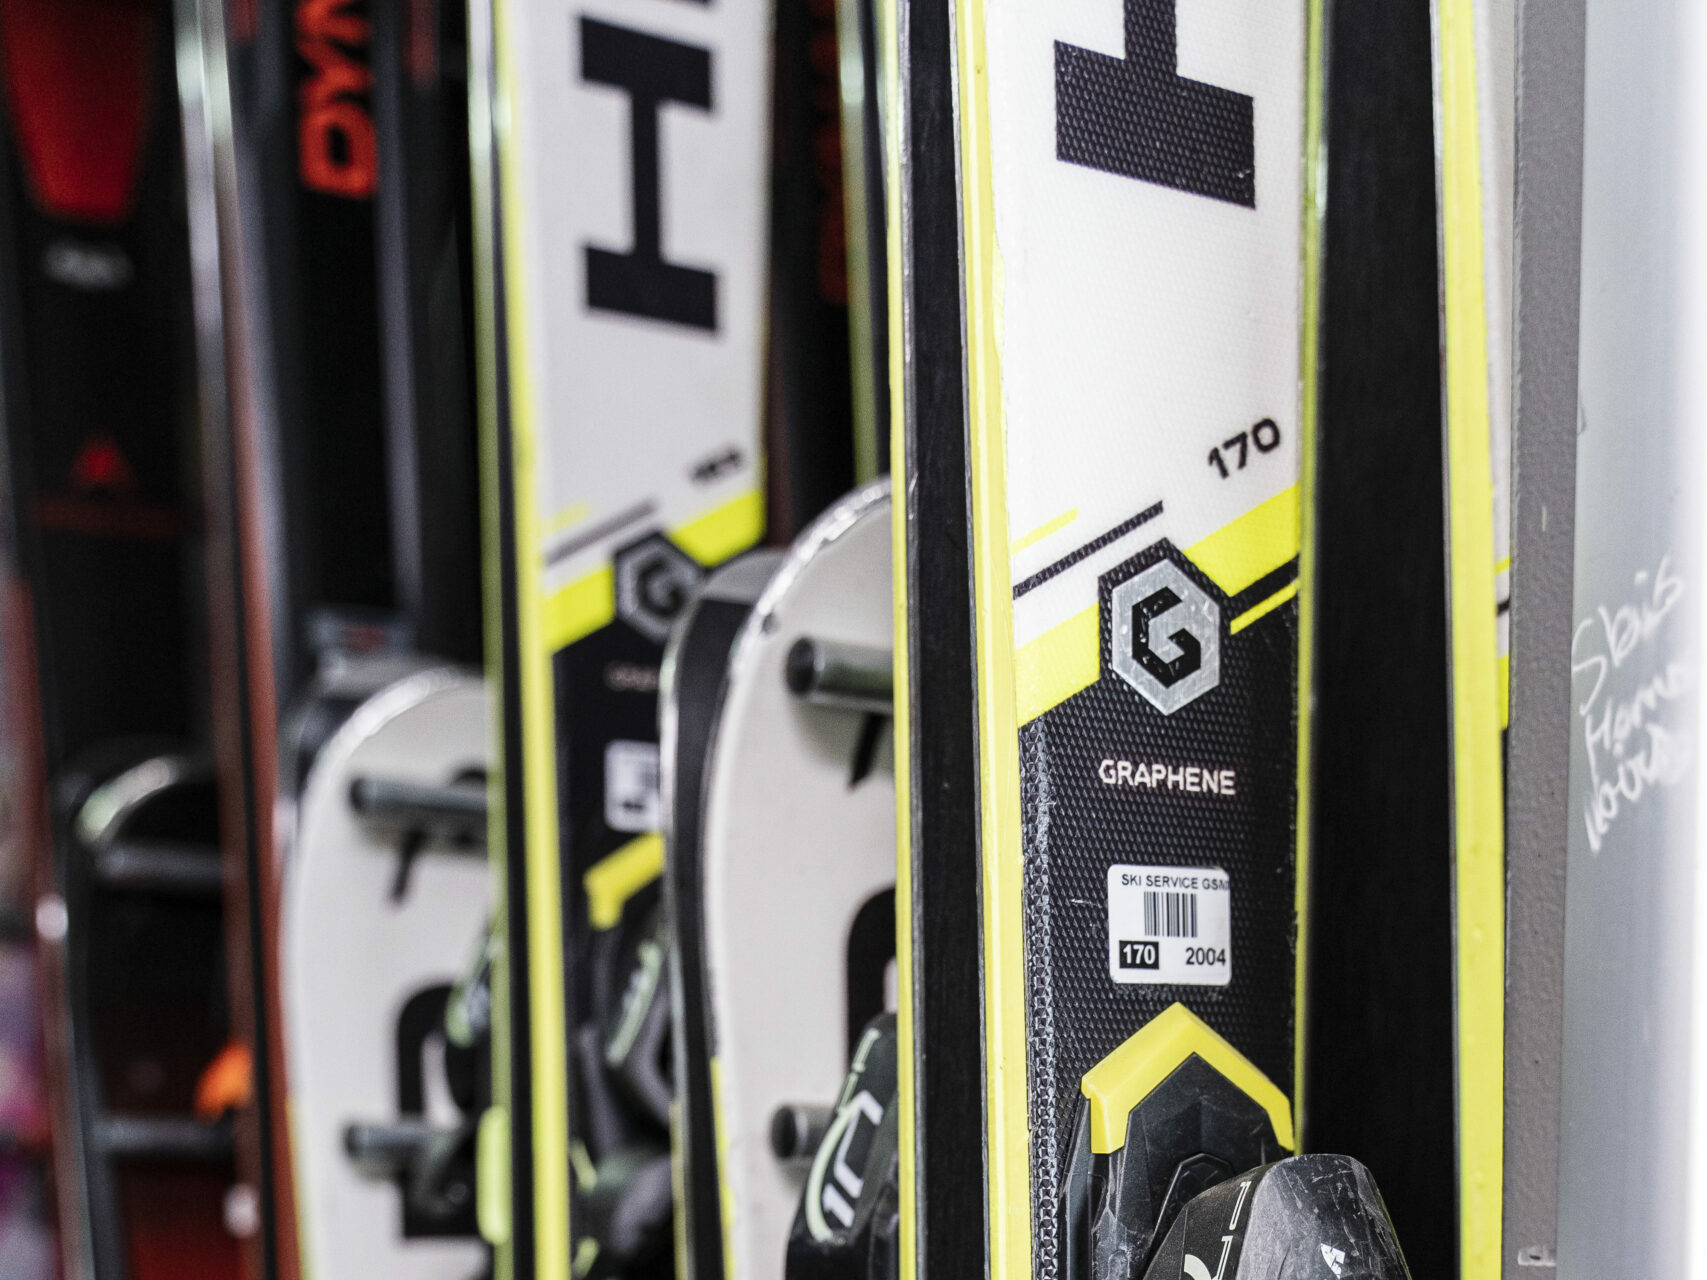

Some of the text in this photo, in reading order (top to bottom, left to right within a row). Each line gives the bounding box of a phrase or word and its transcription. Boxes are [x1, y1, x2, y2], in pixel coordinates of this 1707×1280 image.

[1207, 416, 1282, 480] 170
[1098, 759, 1237, 796] GRAPHENE
[1120, 873, 1142, 887] SKI
[1145, 874, 1199, 890] SERVICE
[1121, 943, 1227, 967] 170 2004
